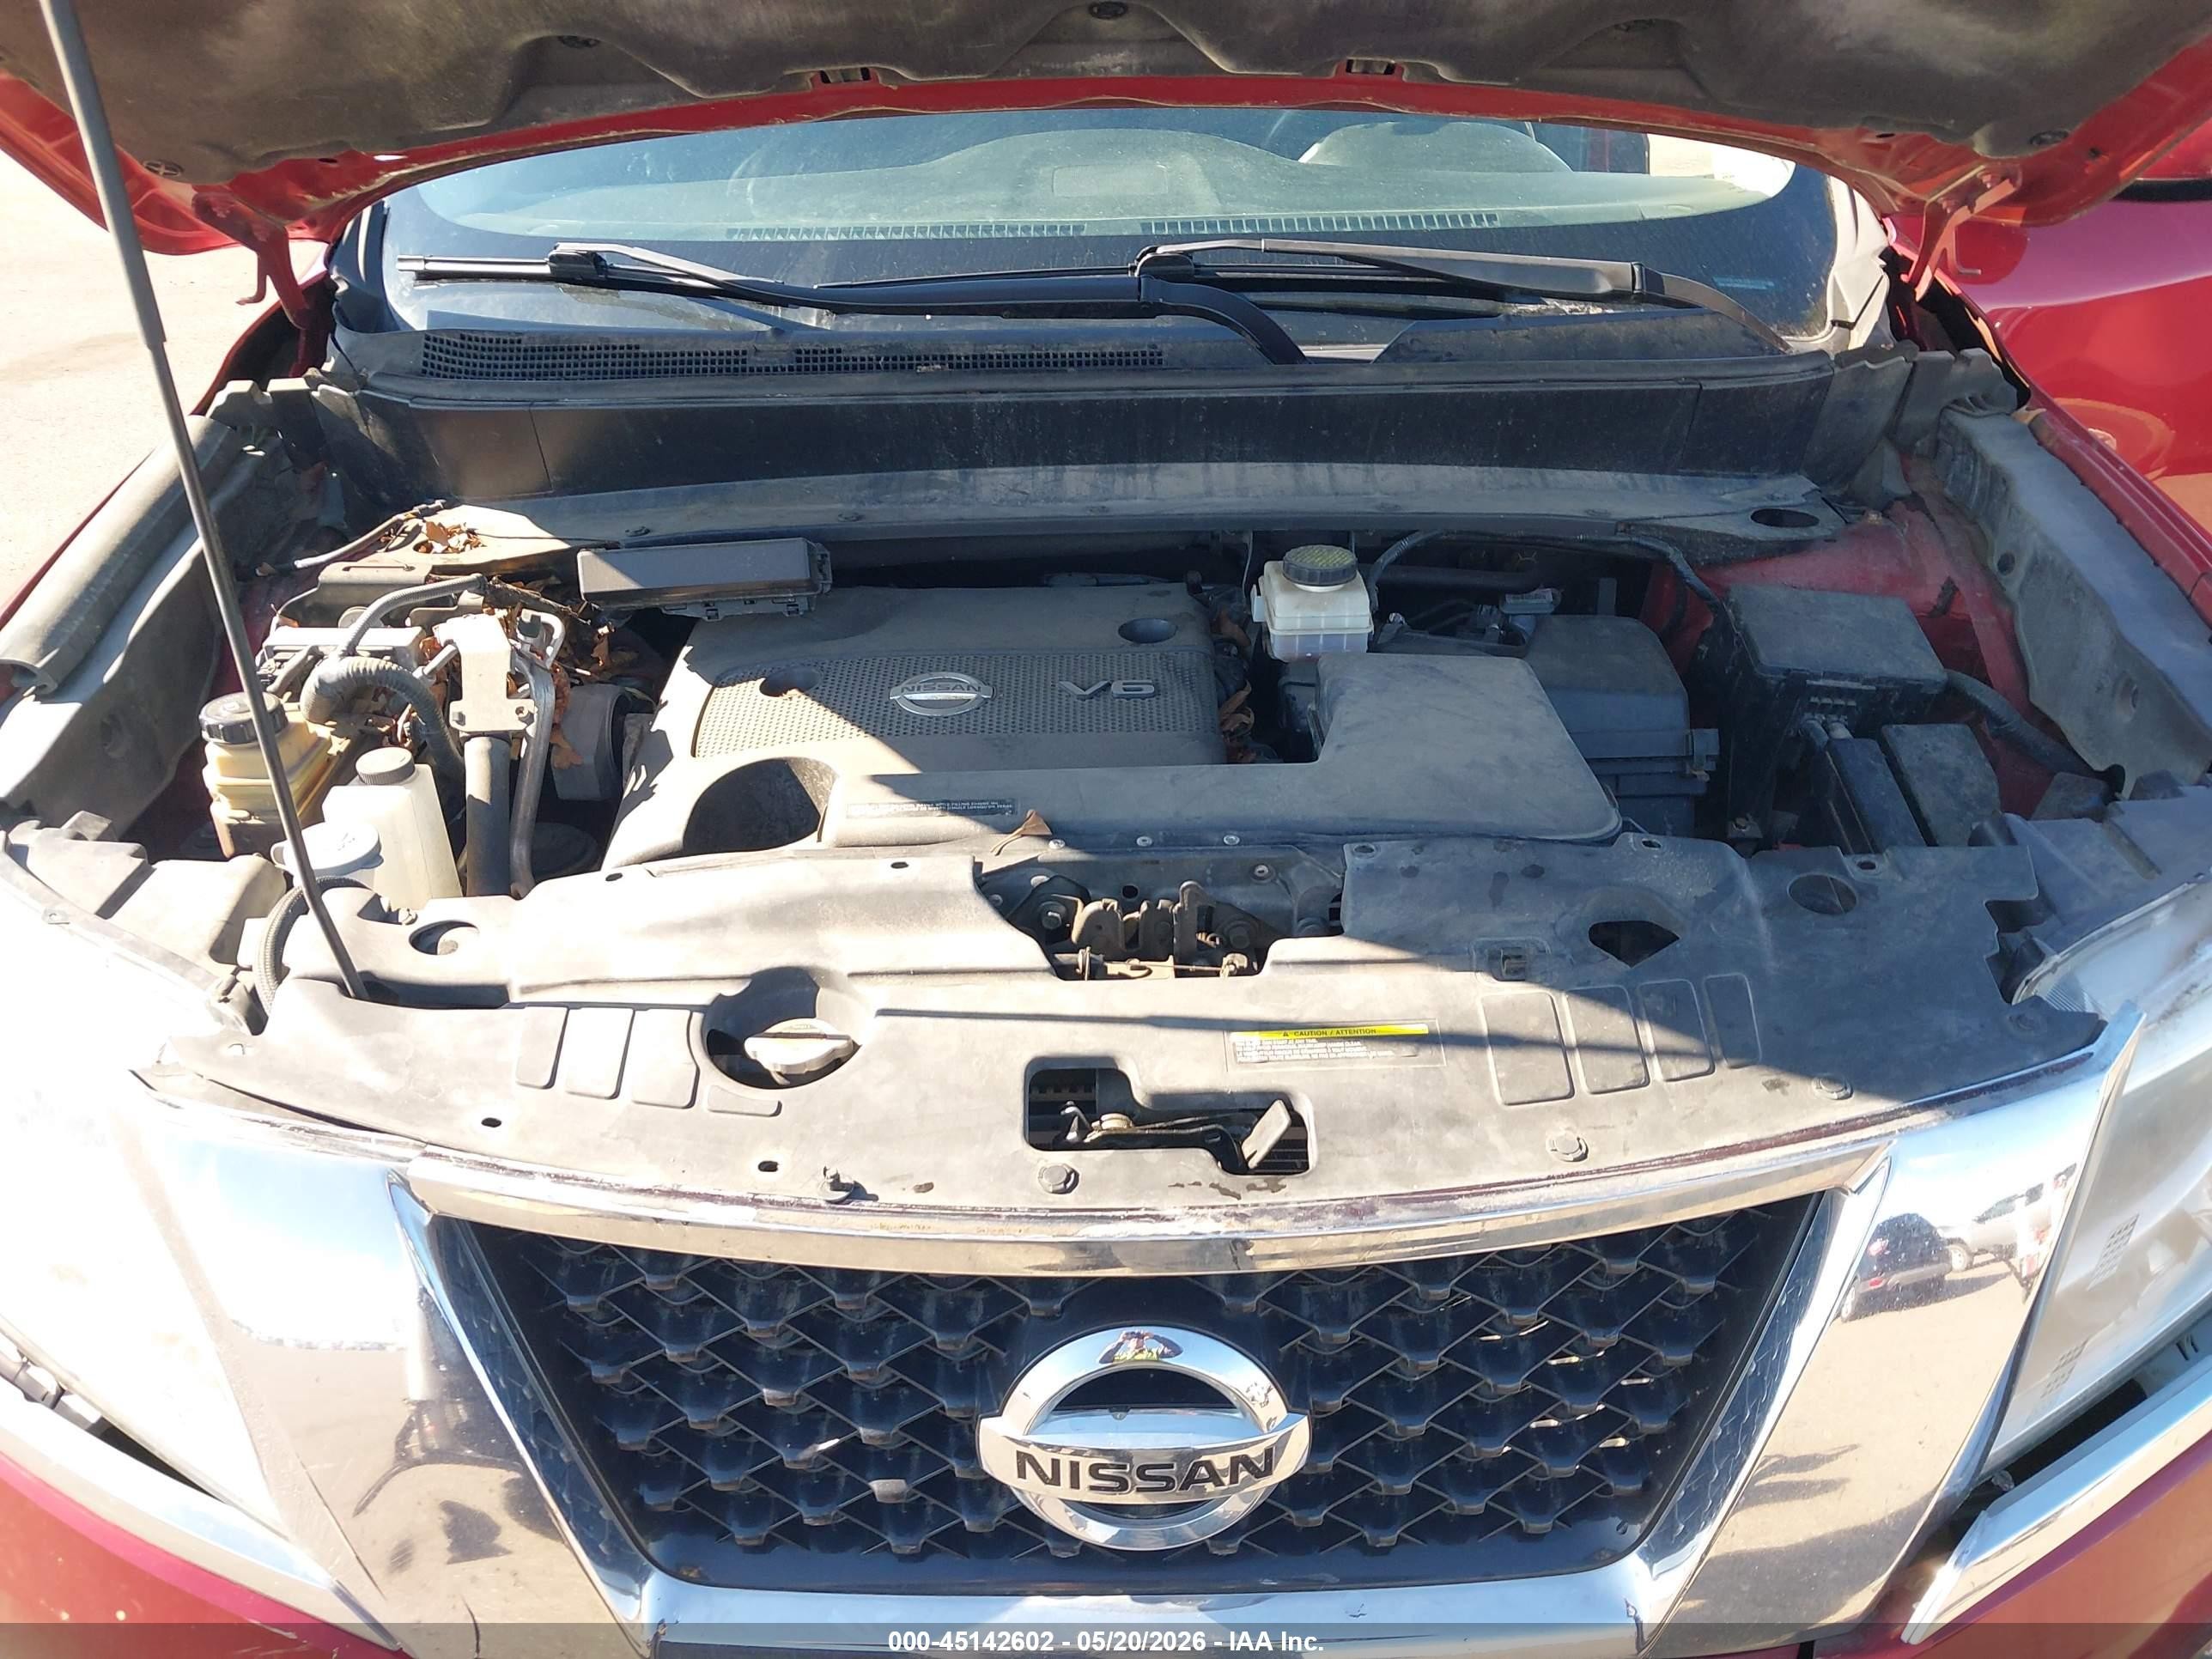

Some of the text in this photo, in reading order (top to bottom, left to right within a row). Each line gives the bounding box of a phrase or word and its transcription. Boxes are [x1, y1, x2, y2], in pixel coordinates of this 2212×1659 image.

[900, 682, 981, 694] NISSAN
[1059, 679, 1156, 699] V6
[1016, 1446, 1275, 1493] NISSAN
